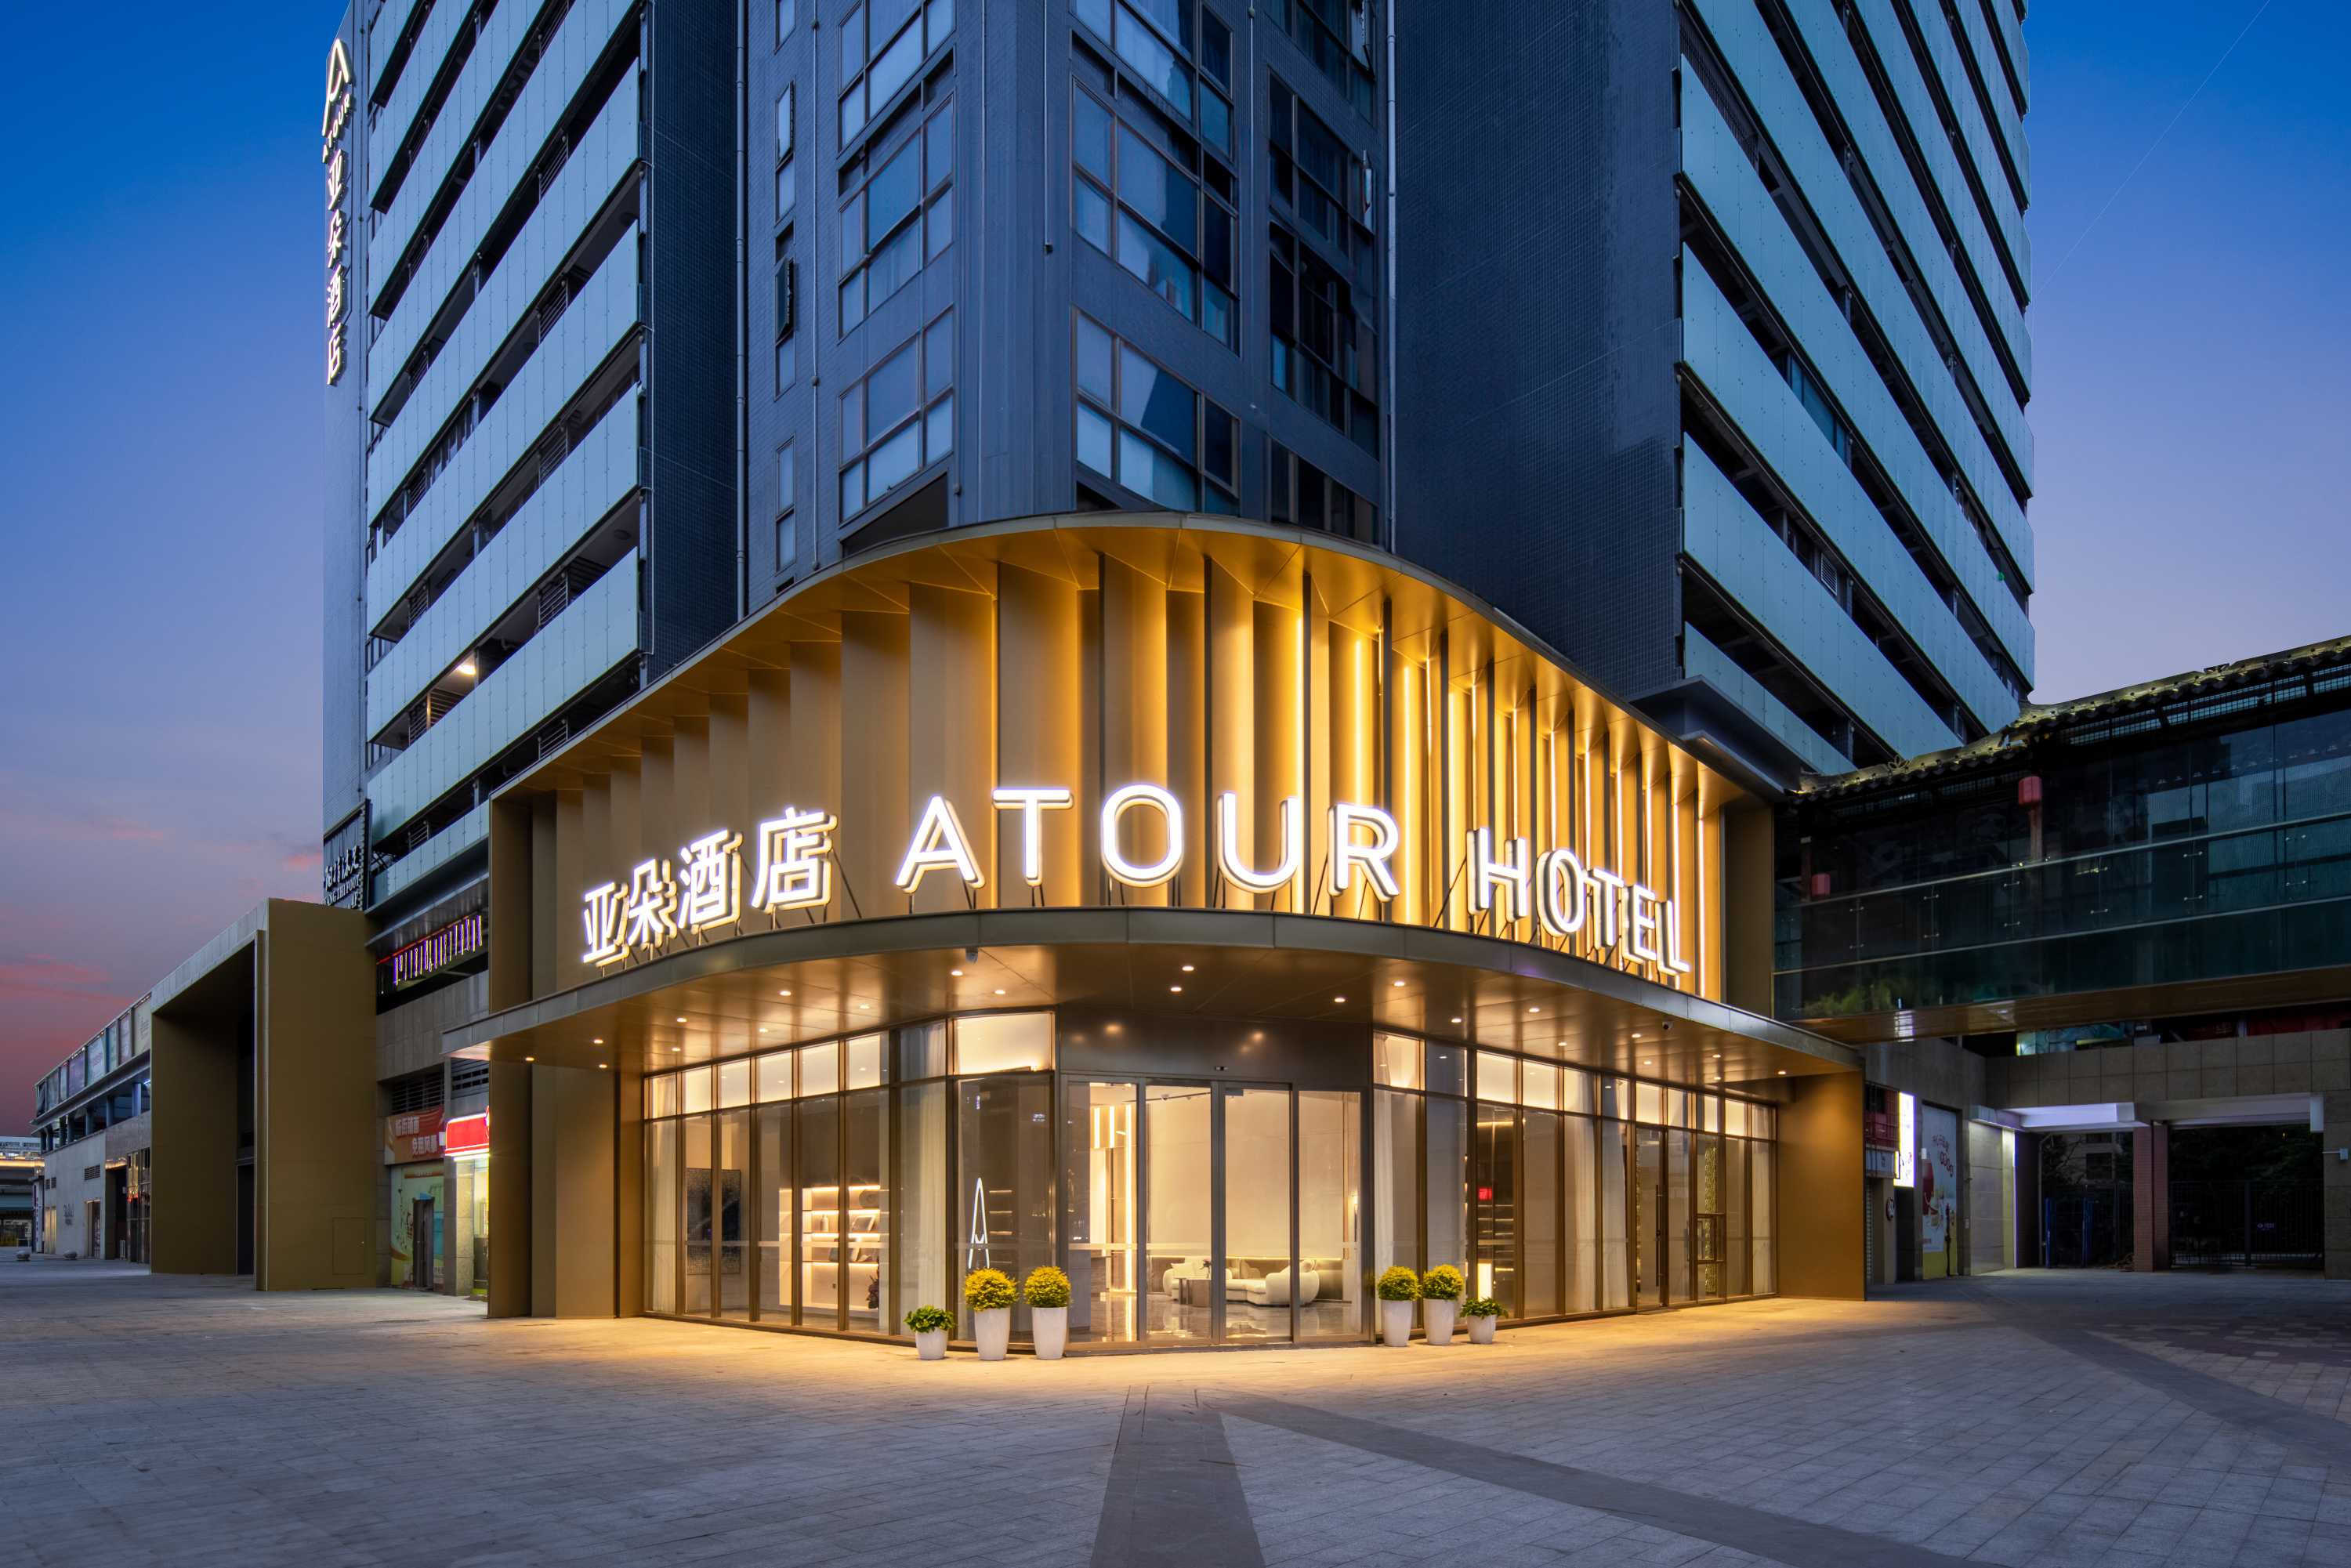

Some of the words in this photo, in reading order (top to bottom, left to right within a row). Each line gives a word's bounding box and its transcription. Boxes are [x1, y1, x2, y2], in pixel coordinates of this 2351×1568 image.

[322, 92, 350, 163] ATOUR
[327, 148, 342, 385] 亚朵酒店
[583, 806, 832, 965] 亚朵酒店
[894, 784, 1400, 902] ATOUR
[1465, 826, 1691, 976] HOTEL
